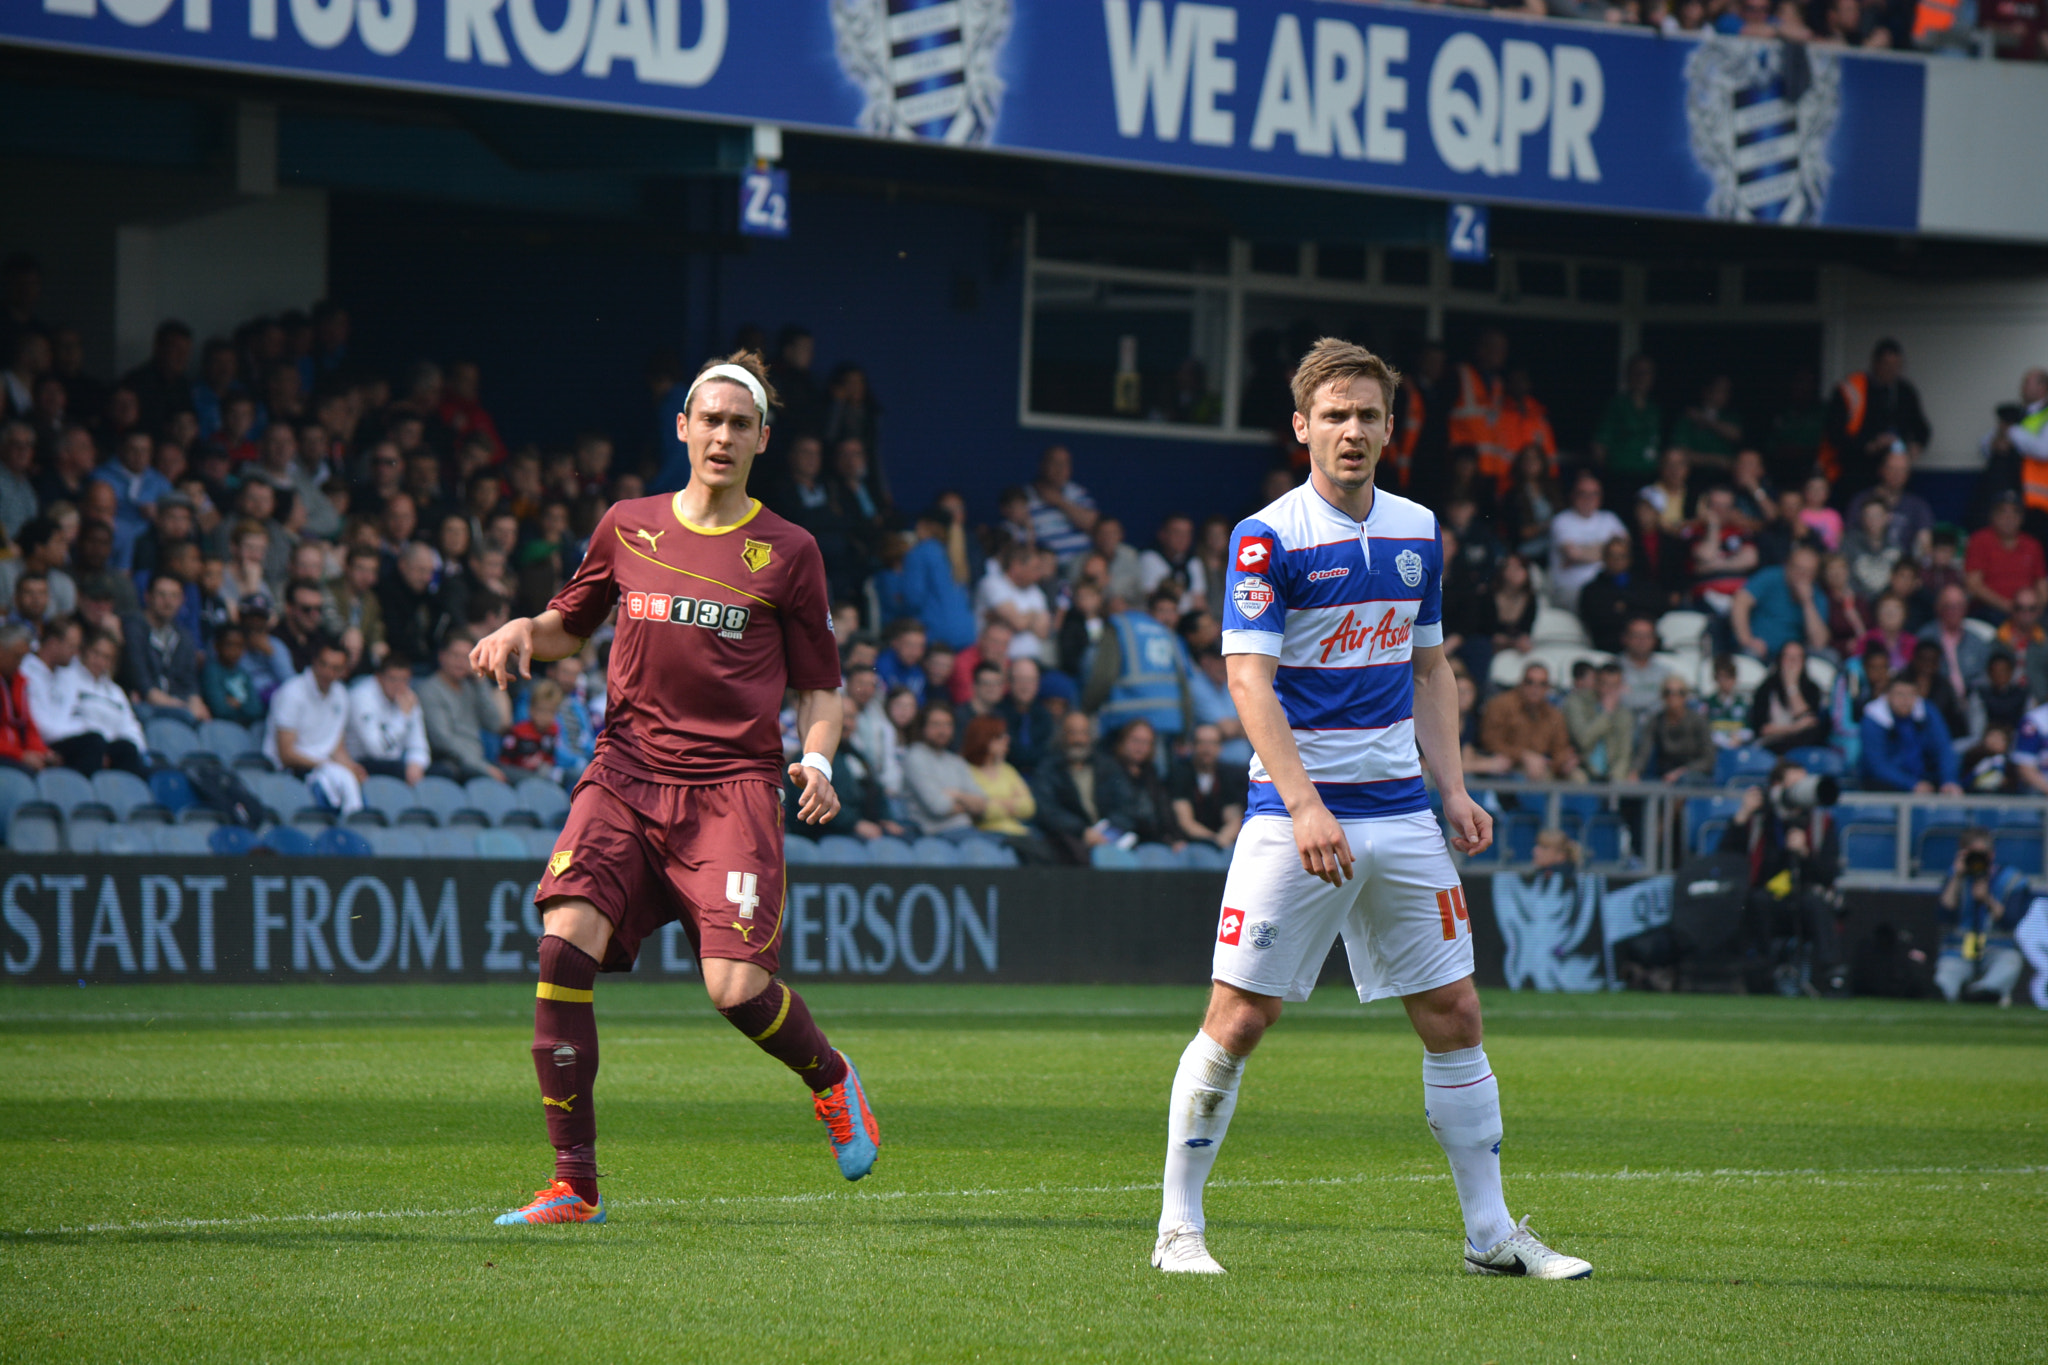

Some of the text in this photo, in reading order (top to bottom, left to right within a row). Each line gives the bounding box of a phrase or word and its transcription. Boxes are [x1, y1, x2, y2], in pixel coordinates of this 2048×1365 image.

[1105, 0, 1603, 182] WE ARE QPR
[744, 175, 788, 231] Z2
[1451, 204, 1487, 256] Z1
[1251, 592, 1271, 601] BET
[727, 871, 760, 920] 4
[1436, 884, 1472, 942] 14
[1, 875, 228, 975] START
[251, 875, 463, 973] FROM
[782, 883, 999, 975] ERSON
